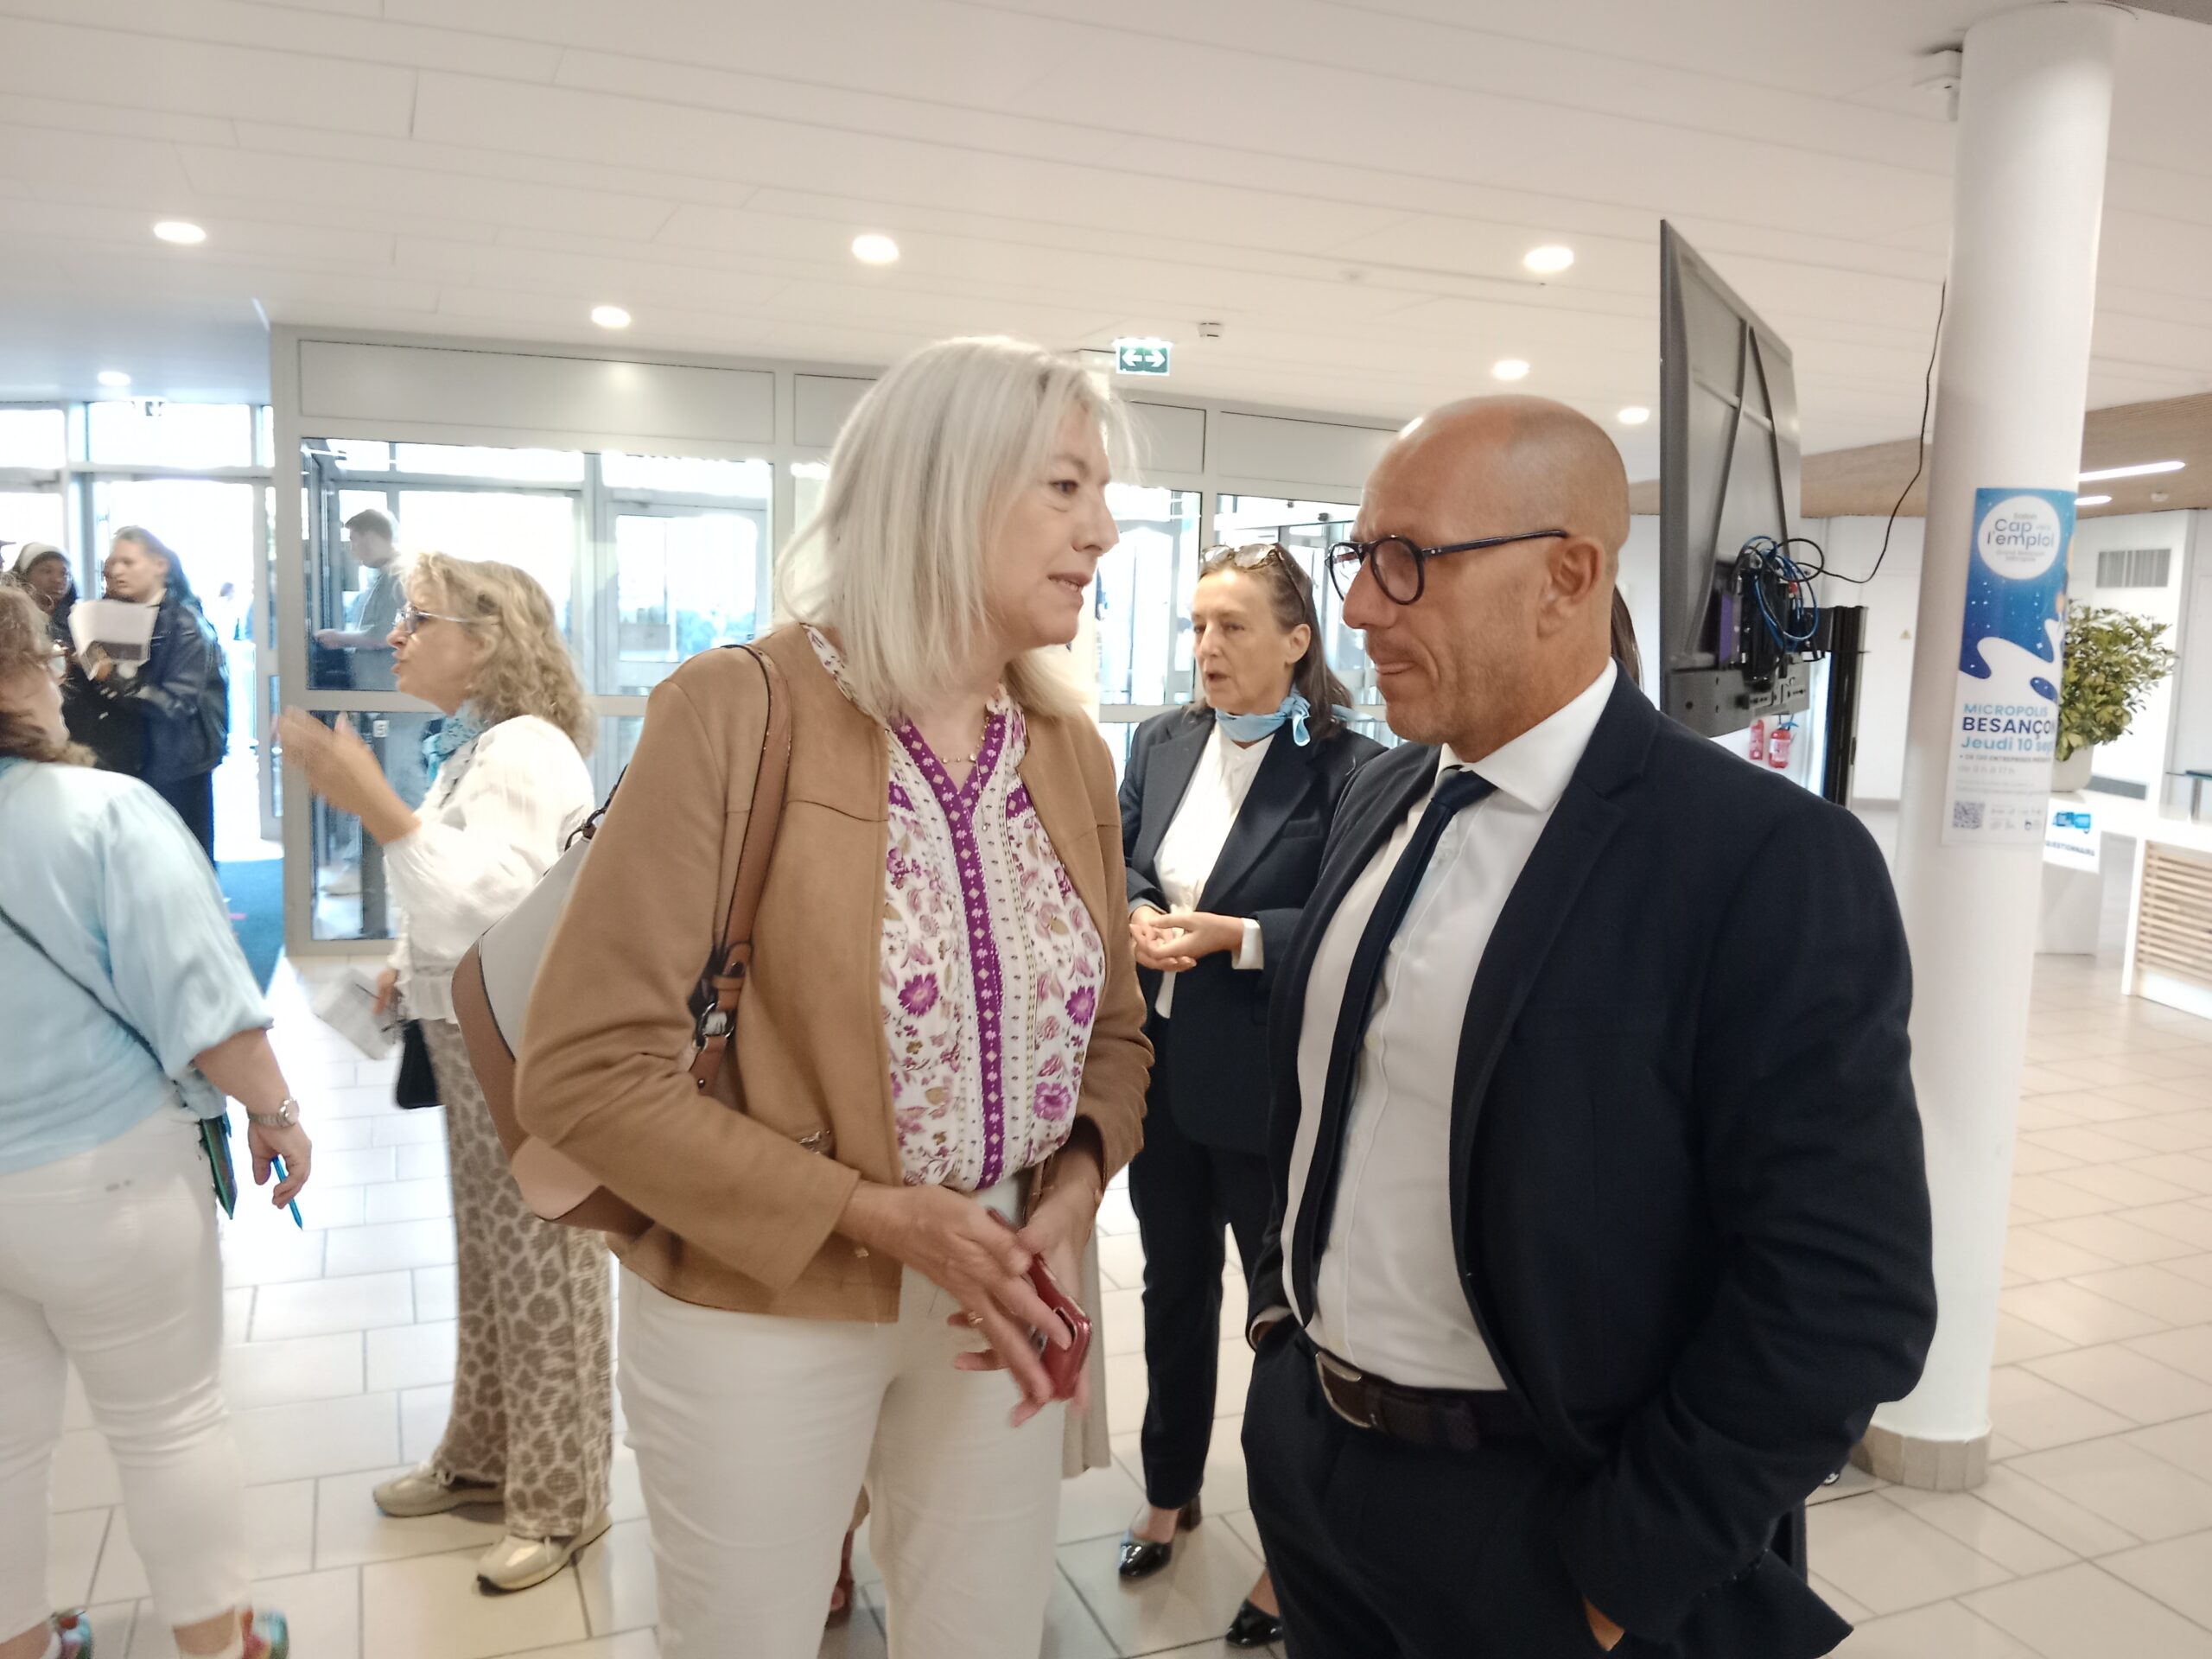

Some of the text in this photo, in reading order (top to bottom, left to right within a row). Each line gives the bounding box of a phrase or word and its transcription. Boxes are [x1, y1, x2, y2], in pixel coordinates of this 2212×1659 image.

[1994, 518, 2032, 536] Cap
[1987, 531, 2054, 550] l'emploi
[1963, 703, 2049, 717] MICROPOLIS
[1961, 735, 2014, 751] Jeudi
[2018, 738, 2033, 752] 10
